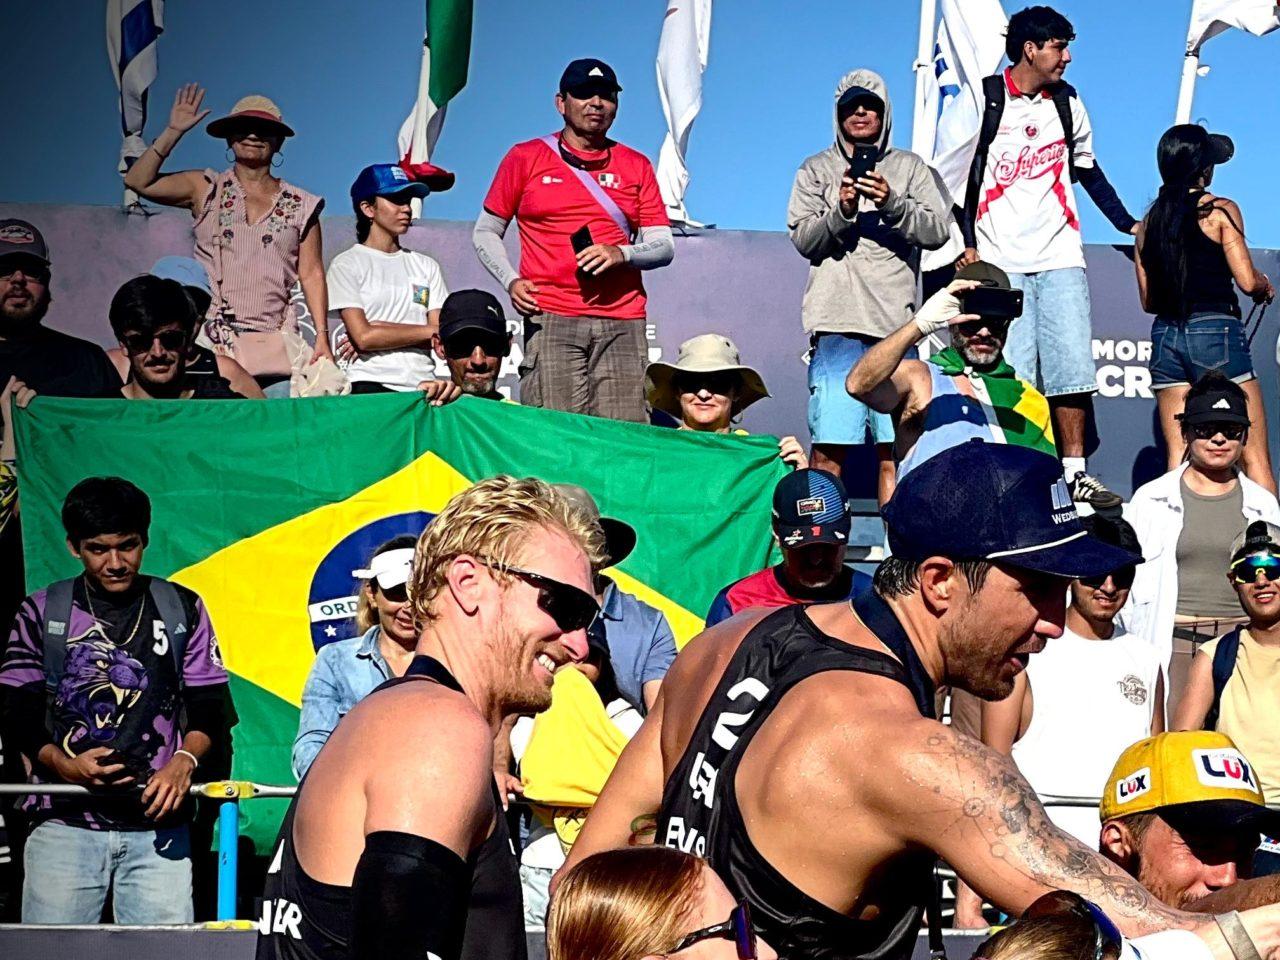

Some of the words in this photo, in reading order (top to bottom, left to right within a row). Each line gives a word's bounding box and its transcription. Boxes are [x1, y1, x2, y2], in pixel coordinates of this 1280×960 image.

[153, 620, 169, 656] 5
[717, 677, 770, 750] 2
[1119, 774, 1146, 797] LUX
[1201, 754, 1256, 789] LUX
